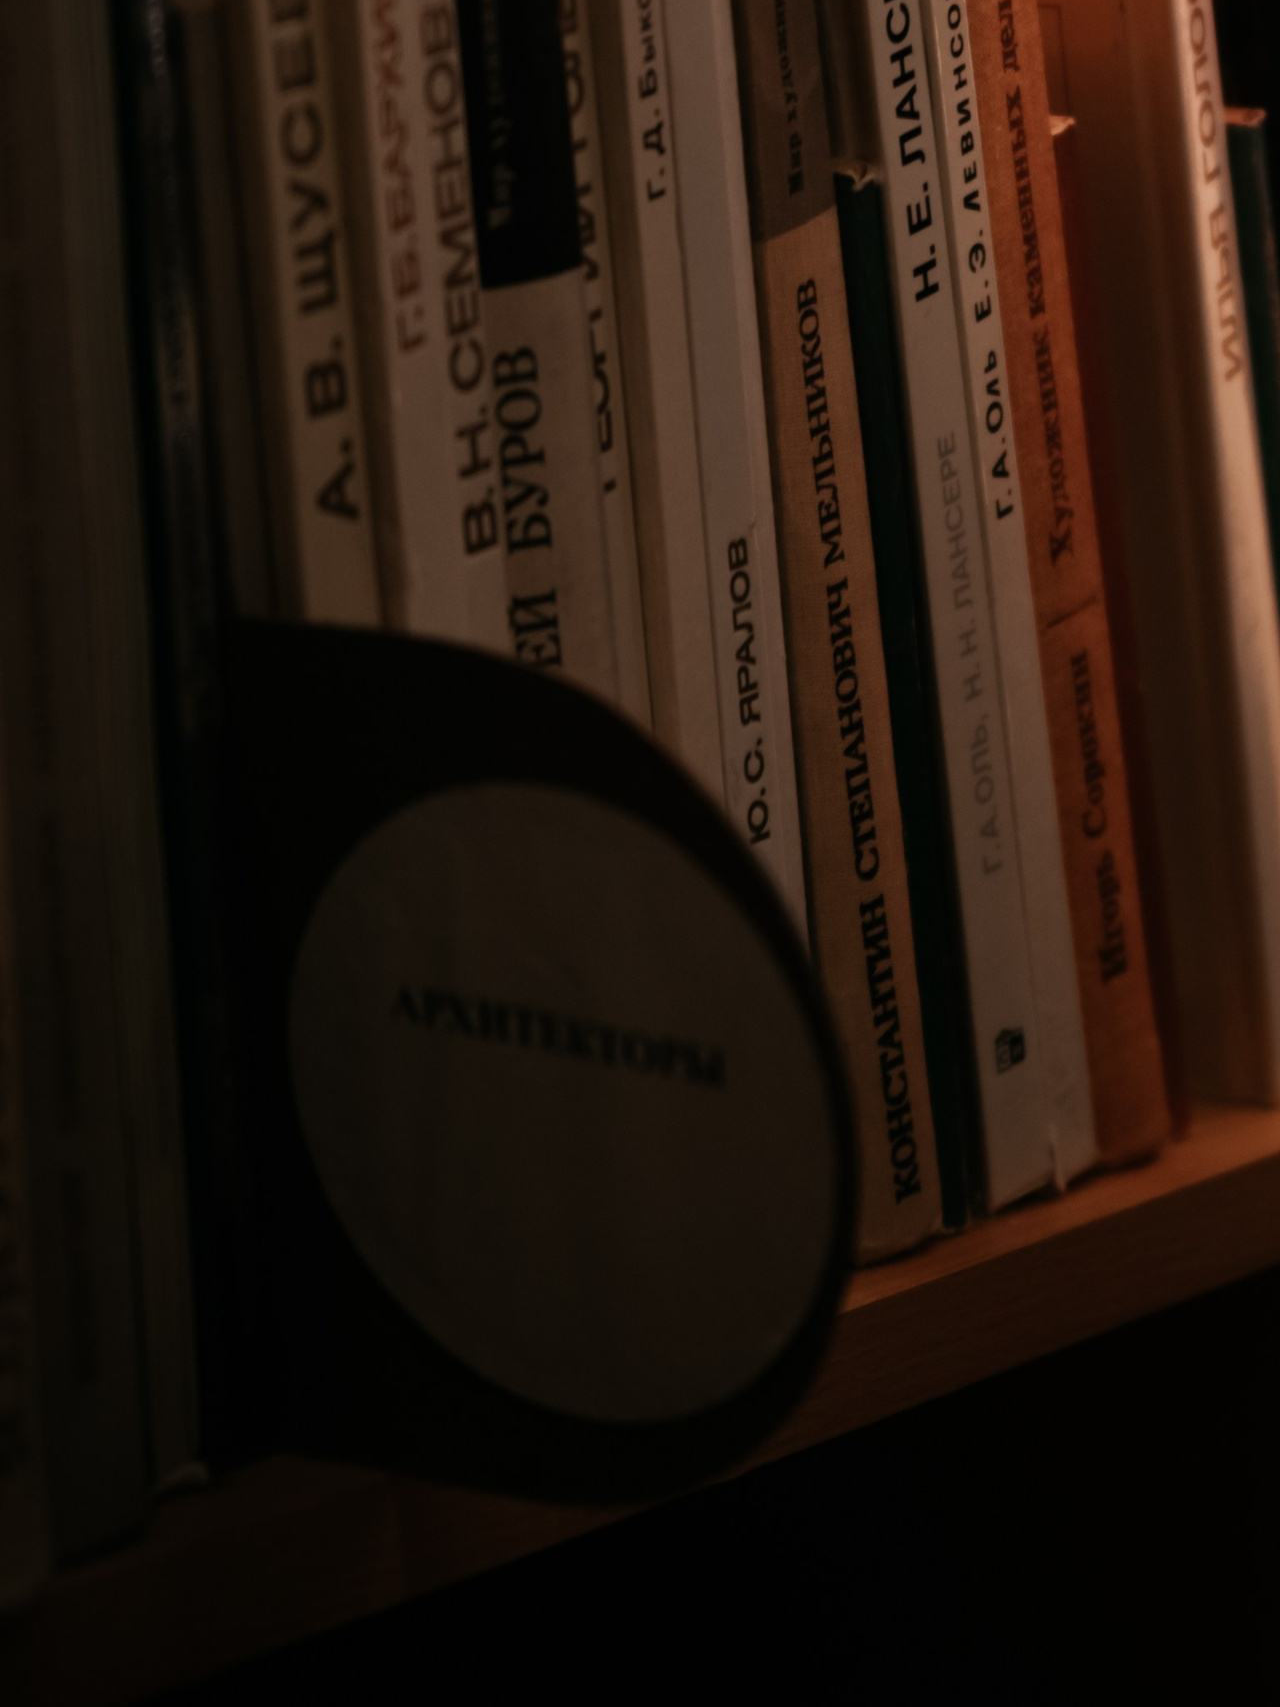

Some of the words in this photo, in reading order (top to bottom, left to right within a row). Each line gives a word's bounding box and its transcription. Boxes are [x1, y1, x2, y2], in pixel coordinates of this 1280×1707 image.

[1005, 85, 1046, 321] каменных
[1206, 200, 1244, 384] ИЛЬЯ
[493, 345, 552, 556] БУРОВ
[795, 278, 845, 568] МЕЛЬНИКОВ
[935, 432, 974, 611] ЛАНСЕРЕ
[1031, 328, 1074, 569] Художник
[726, 536, 761, 726] ЯРАЛОВ
[825, 577, 880, 882] СТЕПАНОВИЧ
[1069, 650, 1107, 840] Сорокин
[1094, 851, 1128, 986] Игорь
[388, 984, 728, 1089] АРХИТЕКТОРЫ
[858, 893, 921, 1204] КОНСТАНТИН
